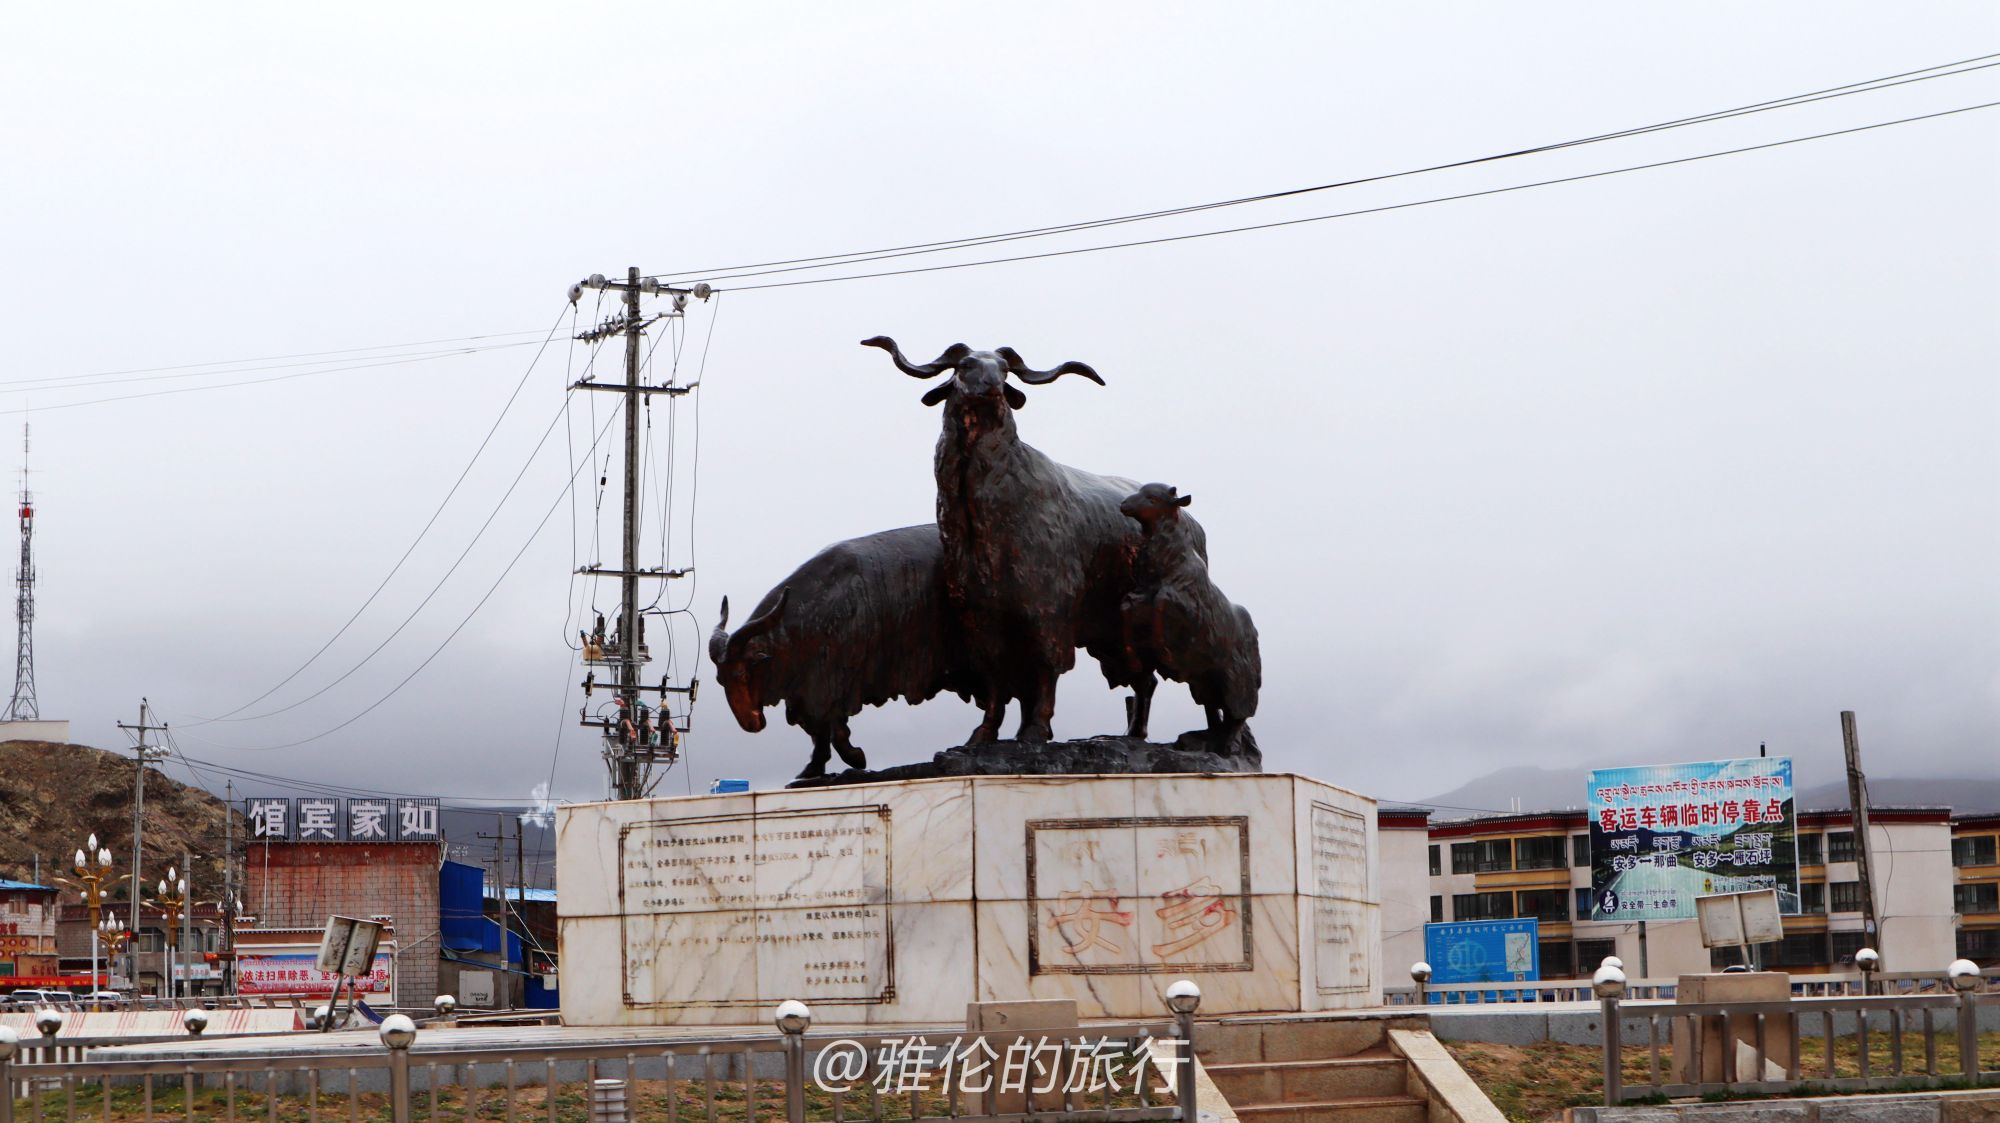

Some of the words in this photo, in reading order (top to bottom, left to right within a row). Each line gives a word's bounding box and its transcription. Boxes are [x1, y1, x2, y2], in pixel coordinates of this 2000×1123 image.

[1600, 798, 1785, 833] 客运车辆临时停靠点
